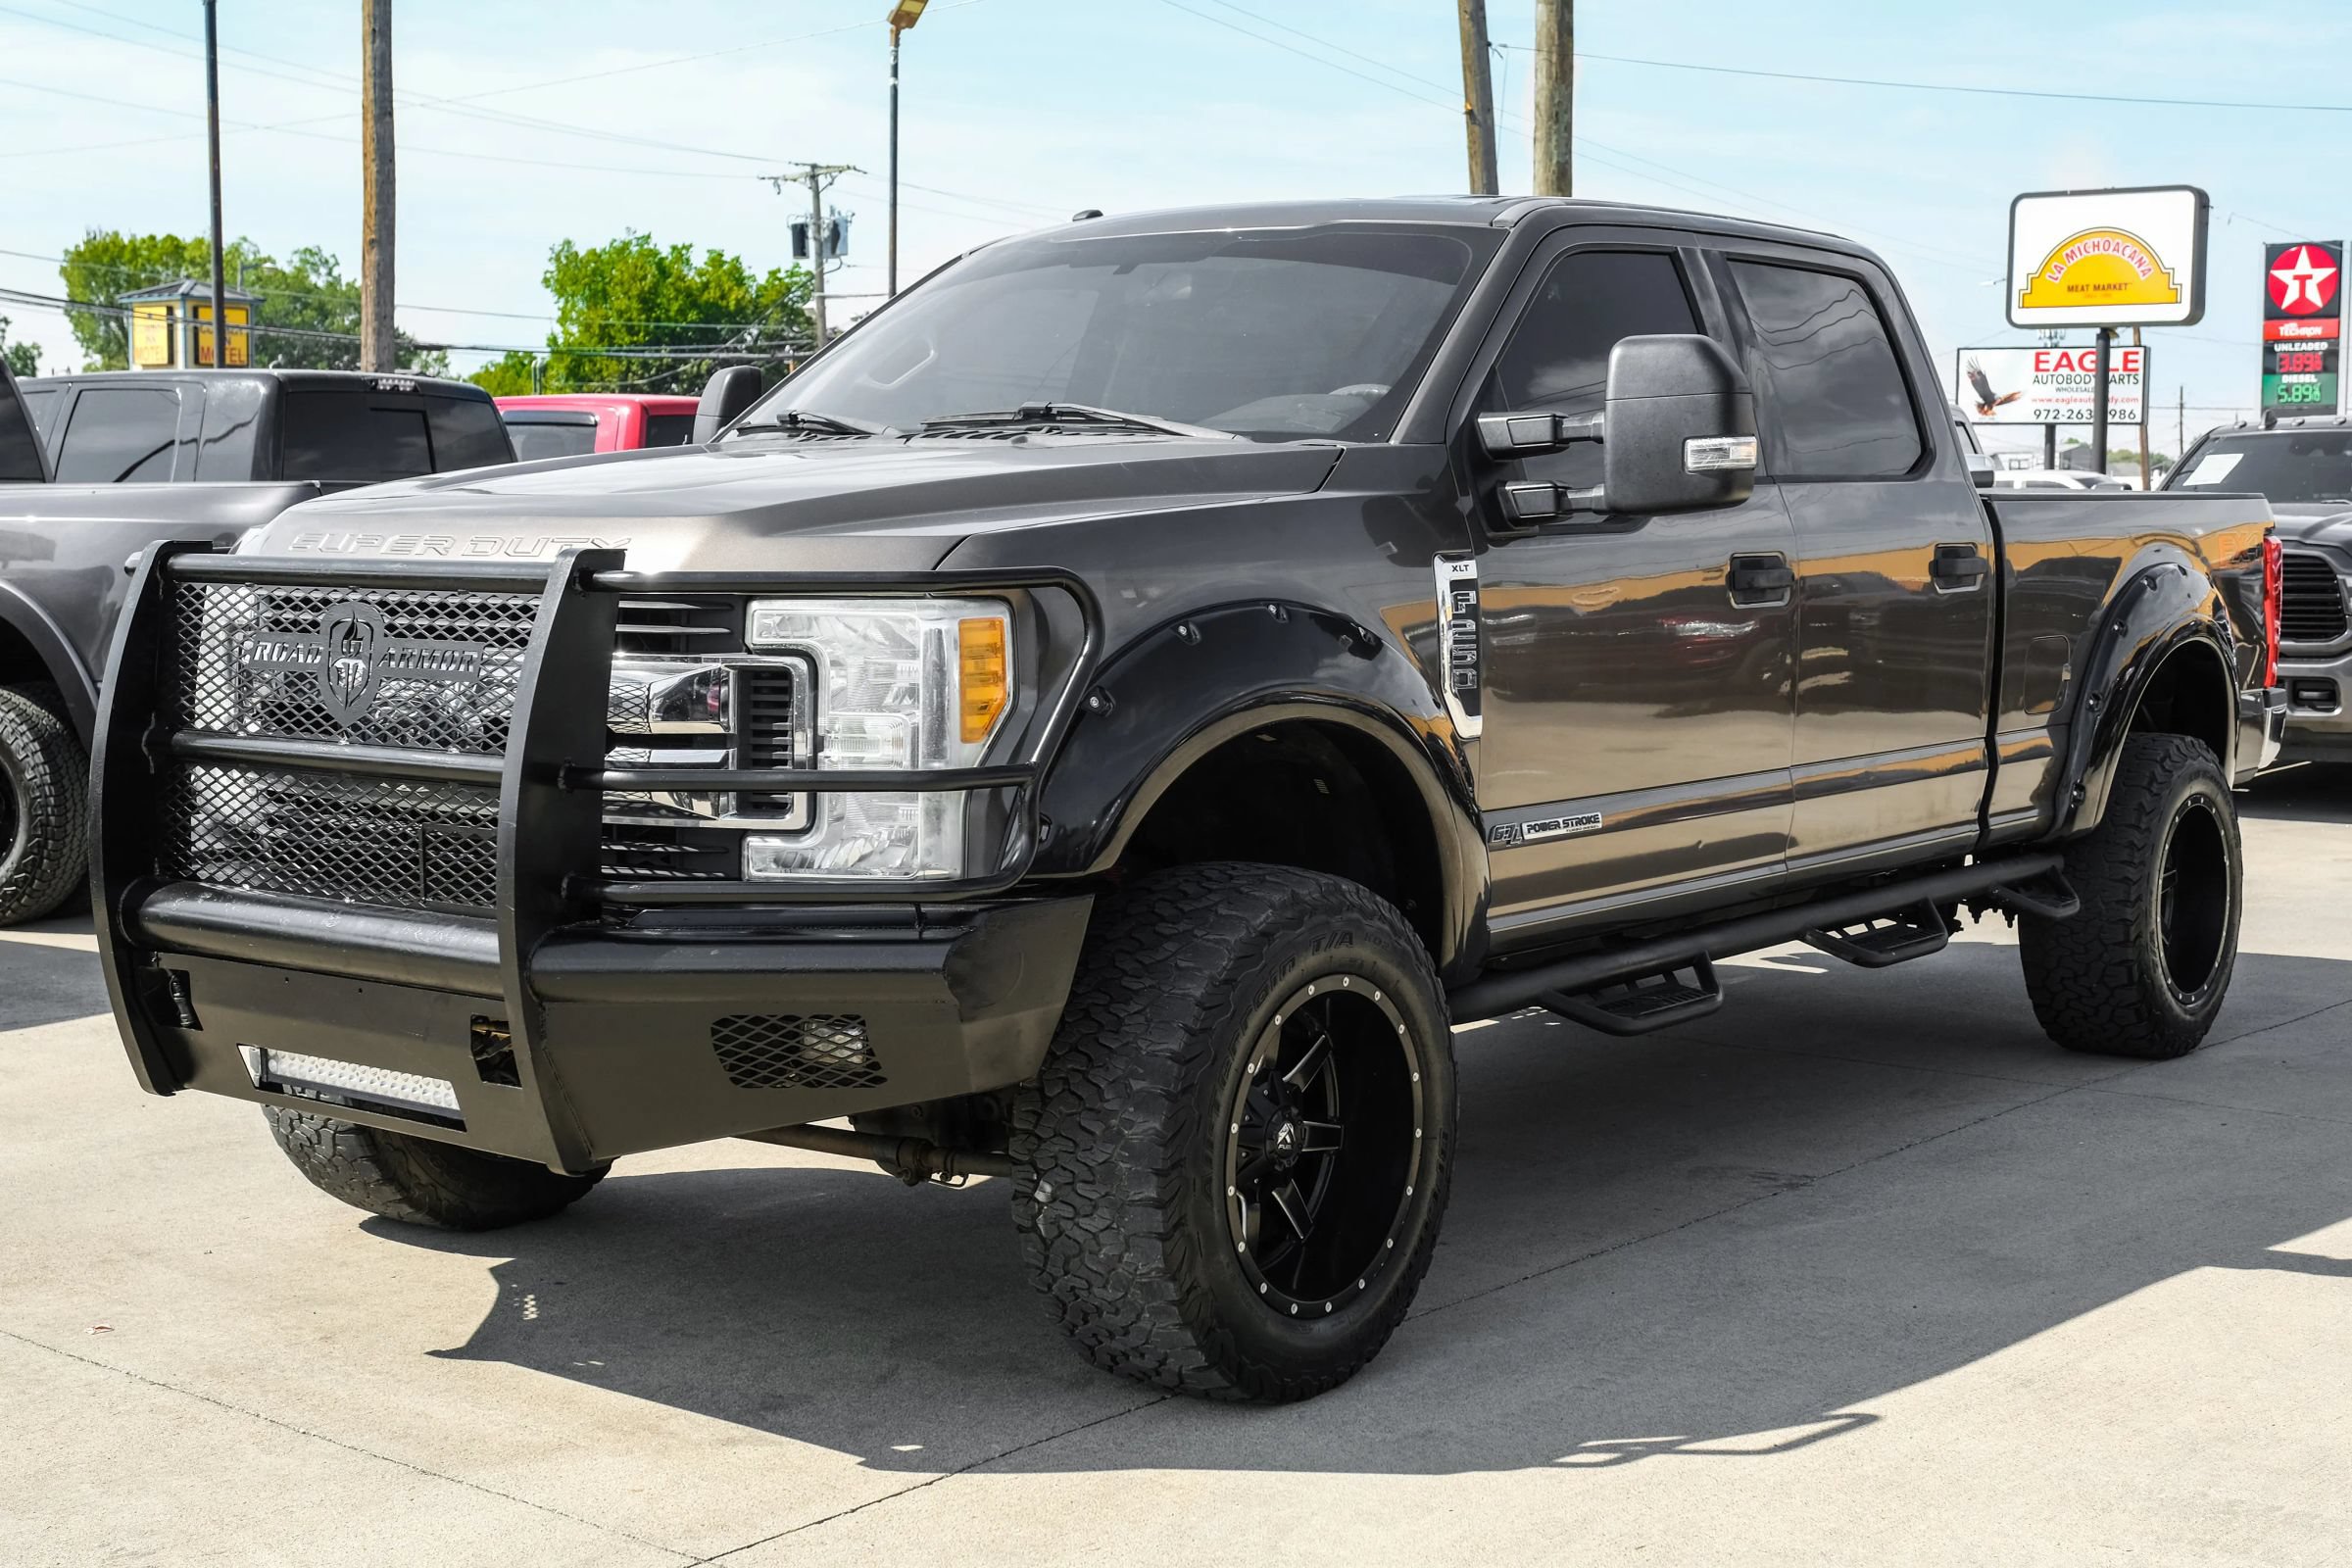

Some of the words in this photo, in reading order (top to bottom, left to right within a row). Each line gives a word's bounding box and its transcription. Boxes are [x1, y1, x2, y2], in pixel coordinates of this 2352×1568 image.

[2046, 264, 2065, 281] LA
[2064, 239, 2152, 277] MICHOACANA
[2093, 282, 2128, 291] MARKET
[2274, 342, 2328, 352] UNLEADED
[2108, 373, 2139, 385] ARTS
[2281, 374, 2318, 383] DIESEL
[288, 532, 457, 557] SUPER
[253, 641, 324, 664] ROAD
[376, 647, 479, 673] ARMOR
[1526, 821, 1561, 834] POWER
[1562, 813, 1600, 829] STROKE
[1309, 932, 1354, 956] T/A
